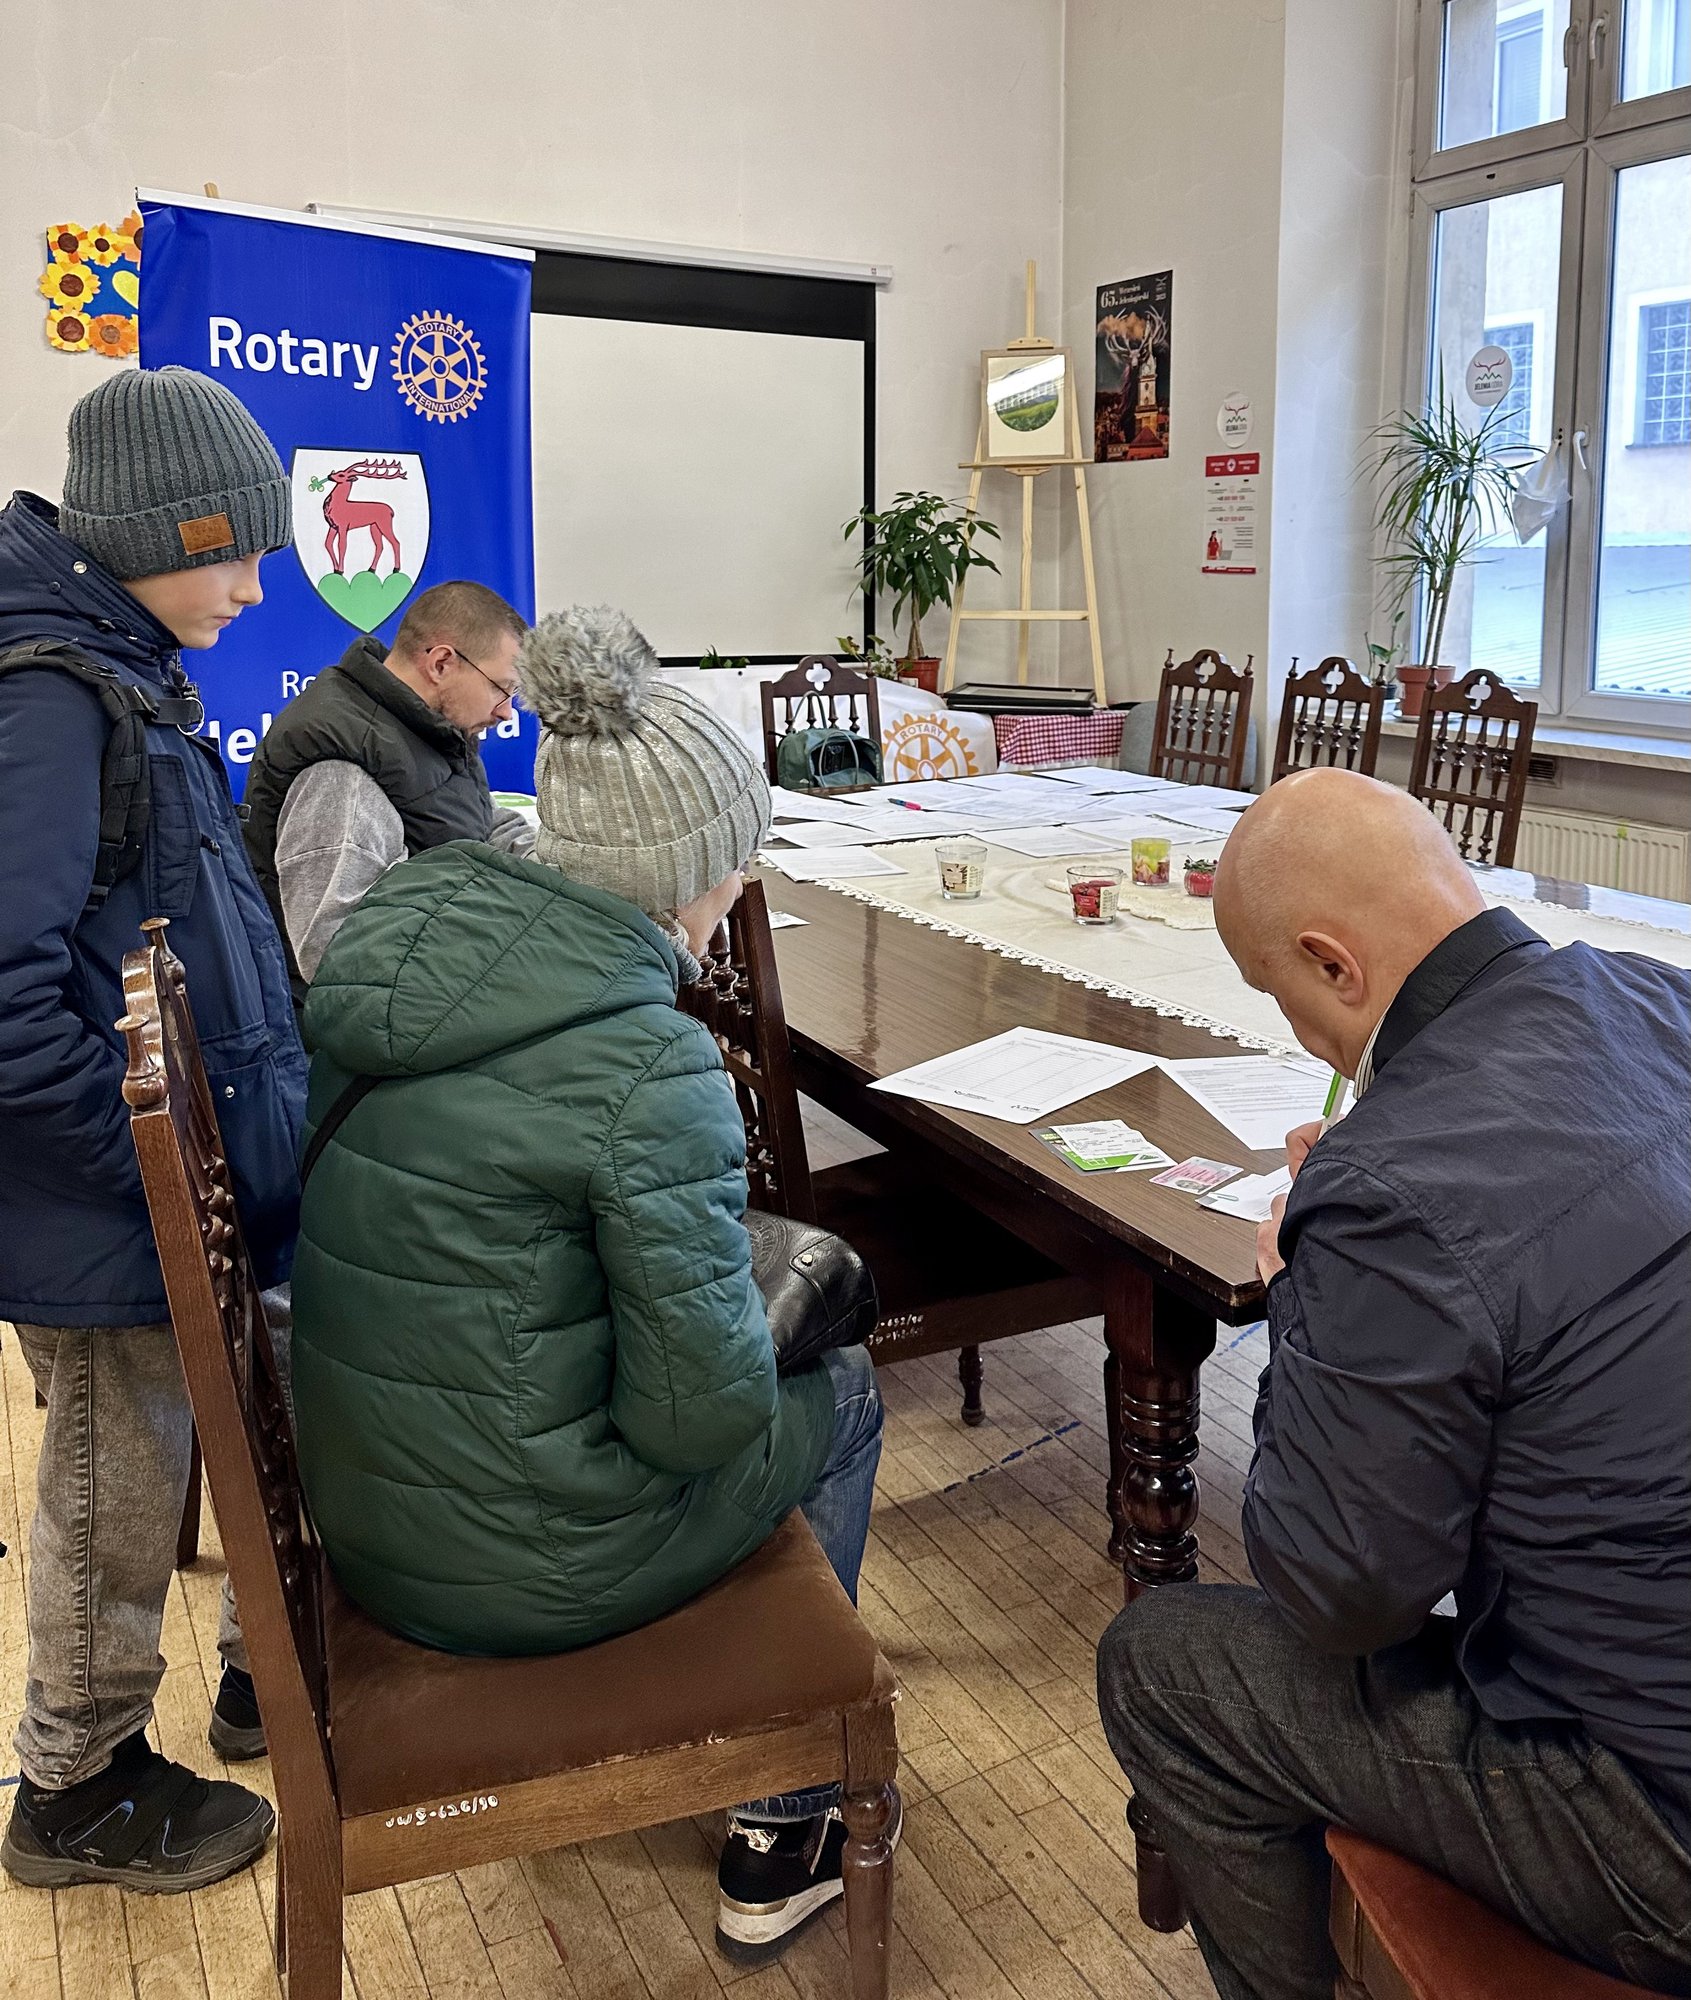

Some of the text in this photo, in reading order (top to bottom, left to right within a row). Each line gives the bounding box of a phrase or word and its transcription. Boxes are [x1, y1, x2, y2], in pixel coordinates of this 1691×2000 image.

[418, 322, 459, 338] ROTARY
[209, 316, 380, 391] Rotary
[407, 382, 474, 413] INTERNATIONAL
[899, 724, 943, 740] ROTARY
